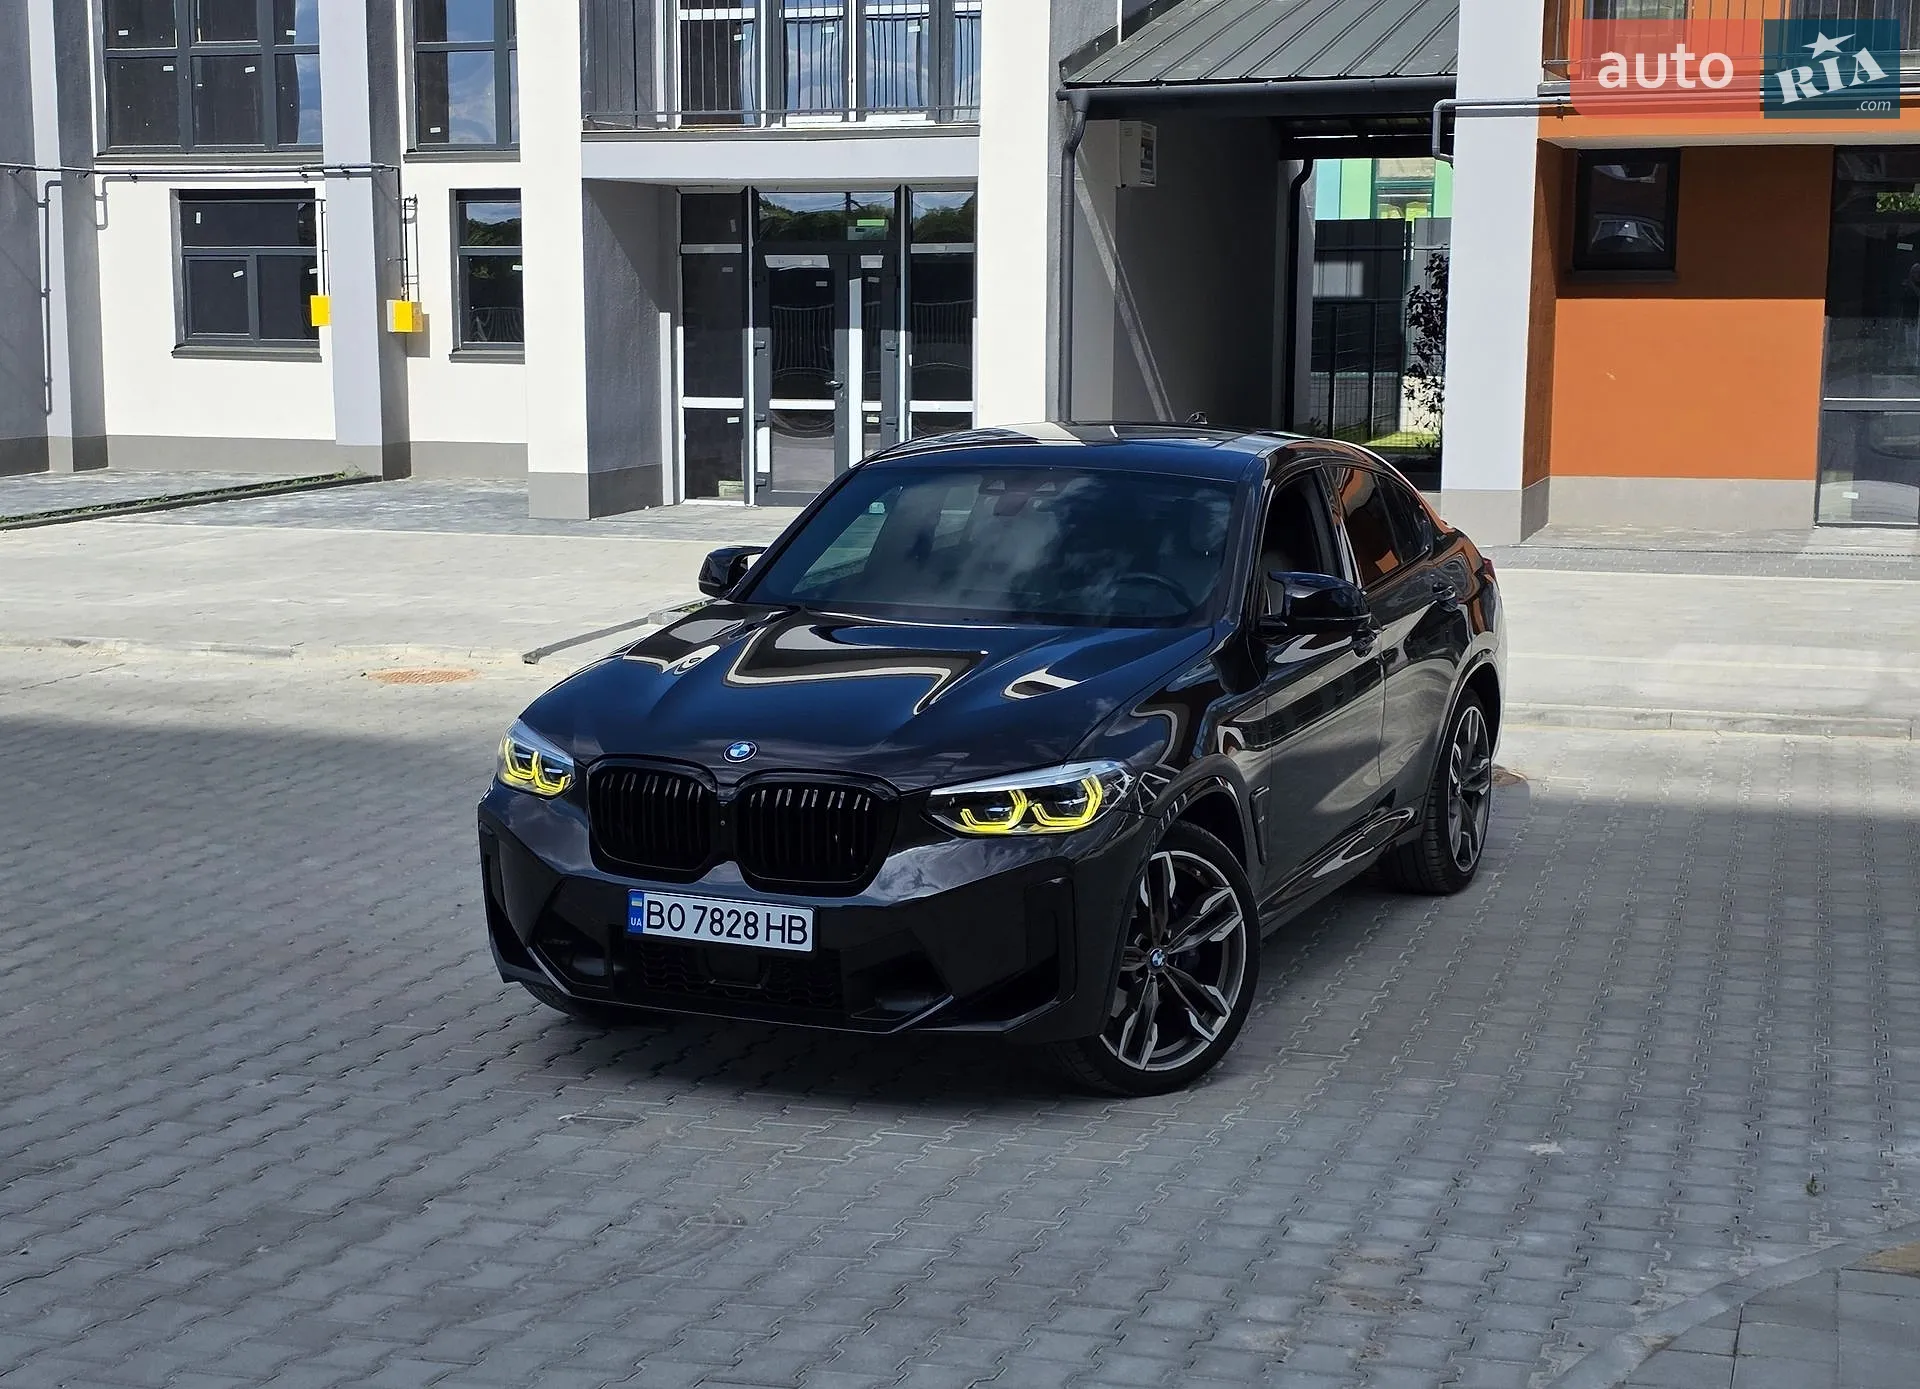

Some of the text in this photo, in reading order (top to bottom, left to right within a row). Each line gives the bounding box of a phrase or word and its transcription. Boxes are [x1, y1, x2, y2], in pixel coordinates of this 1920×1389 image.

[630, 917, 642, 927] UA
[646, 900, 808, 945] BO 7828 HB
